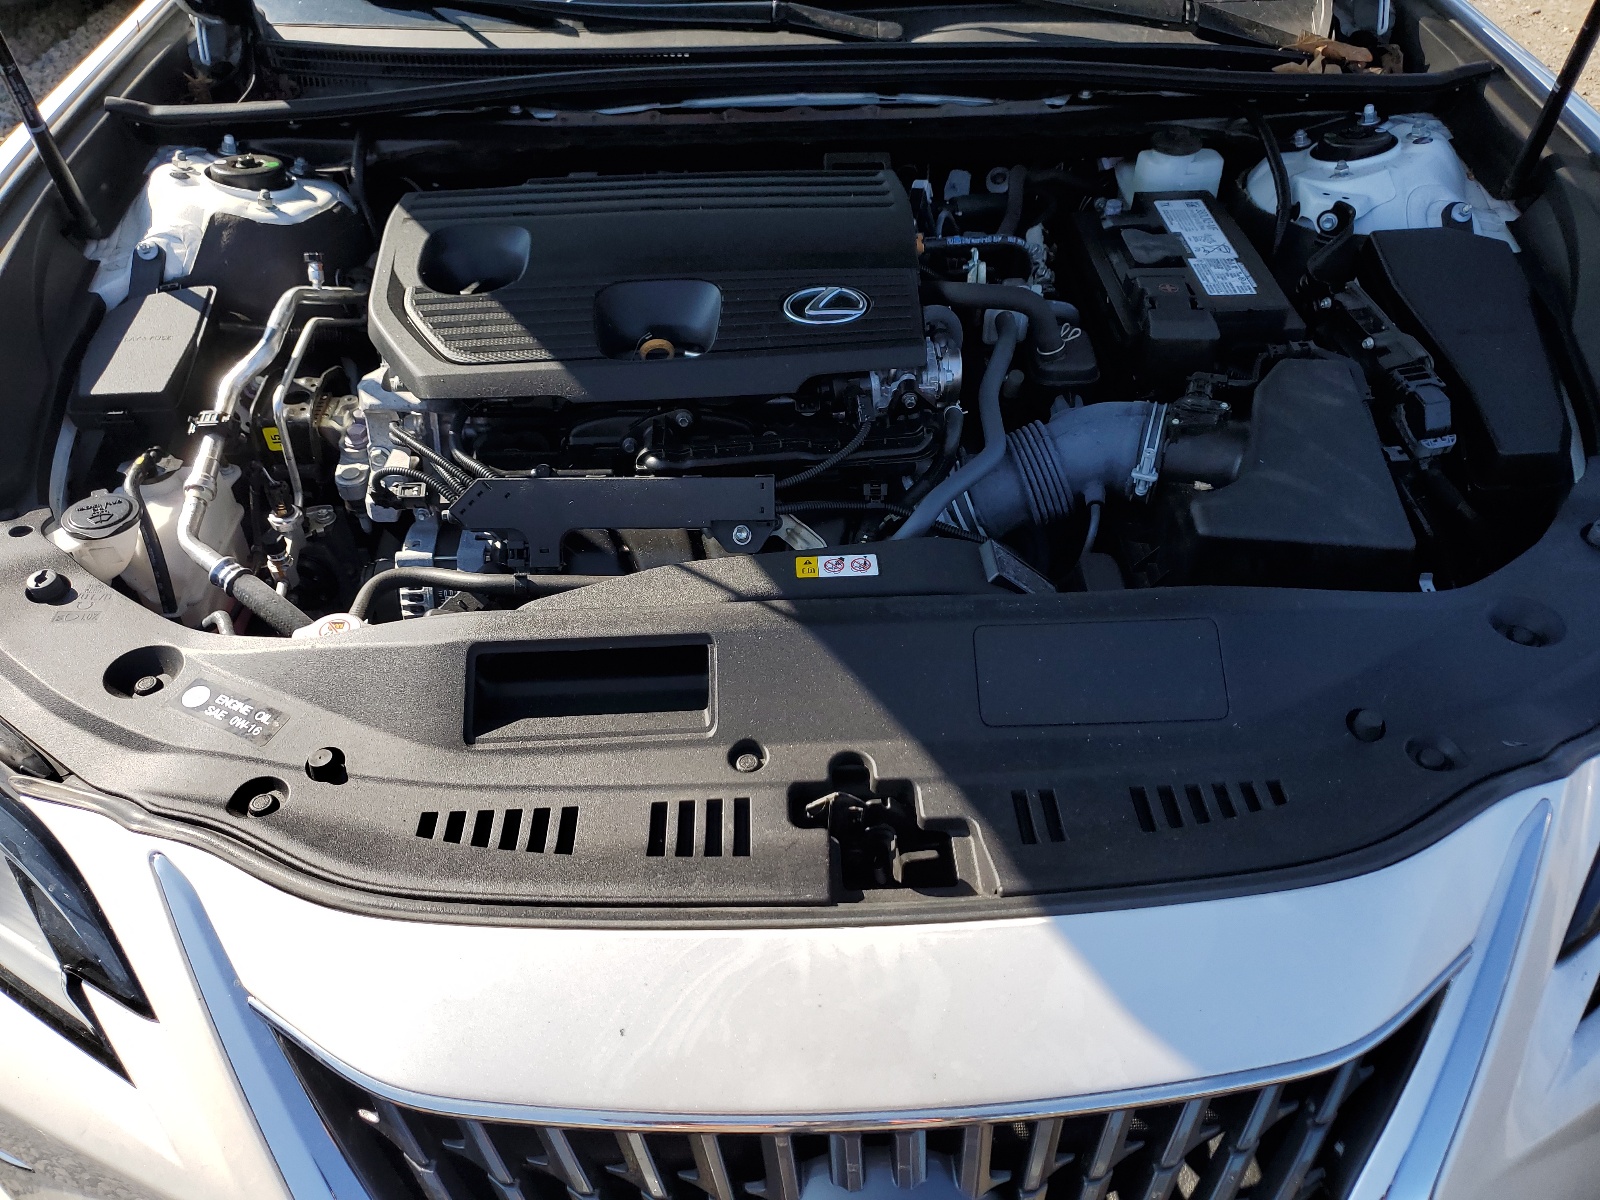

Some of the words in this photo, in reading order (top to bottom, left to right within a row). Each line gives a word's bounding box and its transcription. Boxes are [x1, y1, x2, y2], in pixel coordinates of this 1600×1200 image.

[204, 705, 229, 720] SAE
[215, 694, 254, 715] ENGINE
[254, 711, 272, 725] OIL
